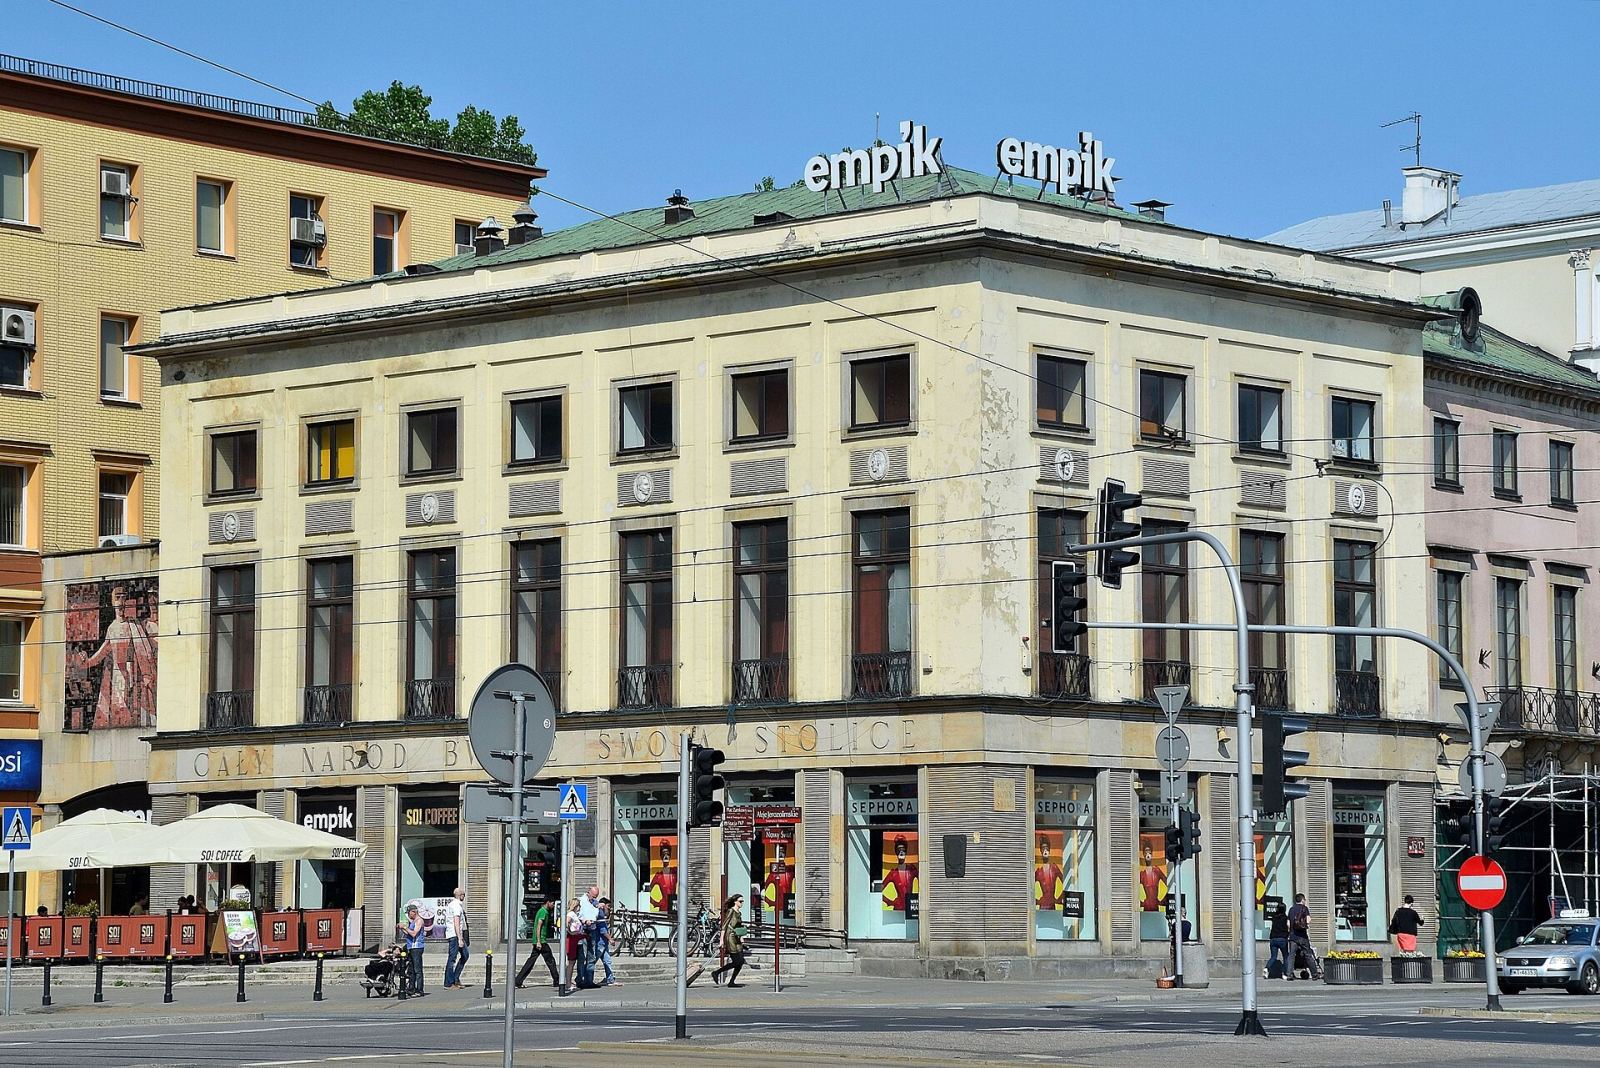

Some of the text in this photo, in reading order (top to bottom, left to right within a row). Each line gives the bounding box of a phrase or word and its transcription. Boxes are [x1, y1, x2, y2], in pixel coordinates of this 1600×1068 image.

[804, 120, 943, 193] empik
[996, 131, 1117, 194] empik
[194, 748, 267, 777] CAŁY
[618, 807, 674, 819] SEPHORA
[851, 801, 913, 813] SEPHORA
[1037, 800, 1090, 815] SEPHORA
[303, 805, 354, 832] empik
[406, 807, 458, 825] SO! COFFEE
[1335, 811, 1382, 824] SEPHORA
[201, 850, 243, 861] SO! COFFEE
[332, 847, 361, 858] SO! COFFEE
[69, 857, 82, 867] SO!
[73, 926, 82, 938] SO!
[108, 926, 120, 938] SO!
[141, 925, 153, 937] SO!
[182, 925, 194, 938] SO!
[274, 922, 286, 934] SO!
[318, 920, 330, 932] SO!
[0, 928, 8, 940] SO
[39, 927, 51, 939] SO!
